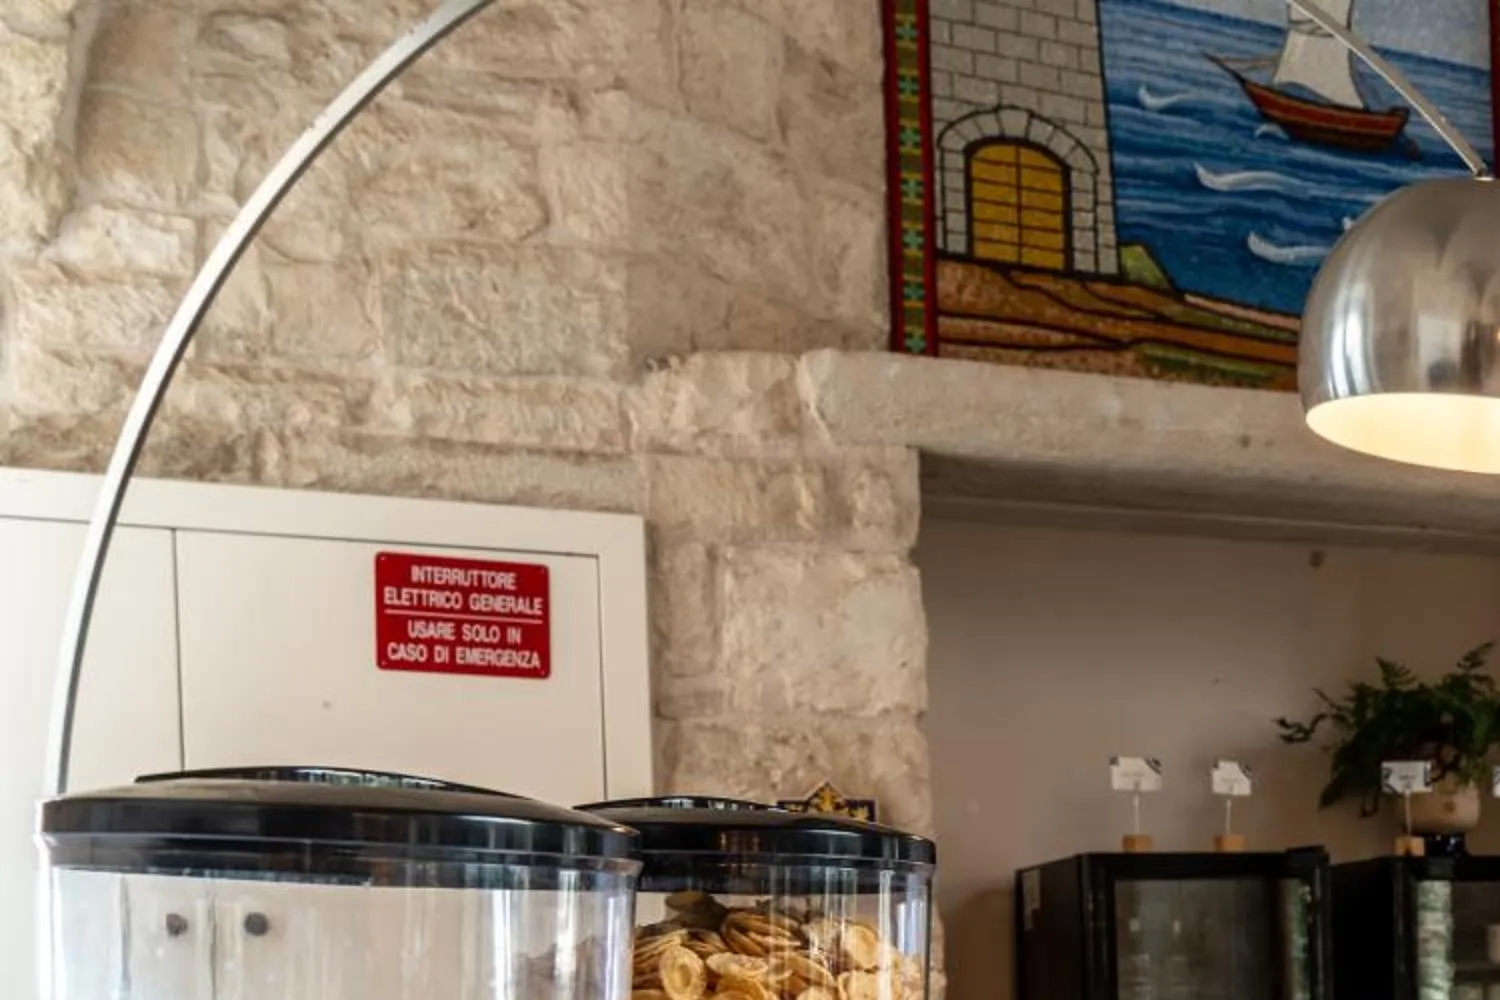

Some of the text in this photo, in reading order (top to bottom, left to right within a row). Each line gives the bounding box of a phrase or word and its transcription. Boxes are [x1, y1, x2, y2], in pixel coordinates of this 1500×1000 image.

[411, 565, 516, 590] INTERRUTTORE
[384, 586, 543, 615] ELETTRICO GENERALE
[407, 619, 521, 645] USARE SOLO IN
[387, 642, 541, 669] CASO DI EMERGENZA
